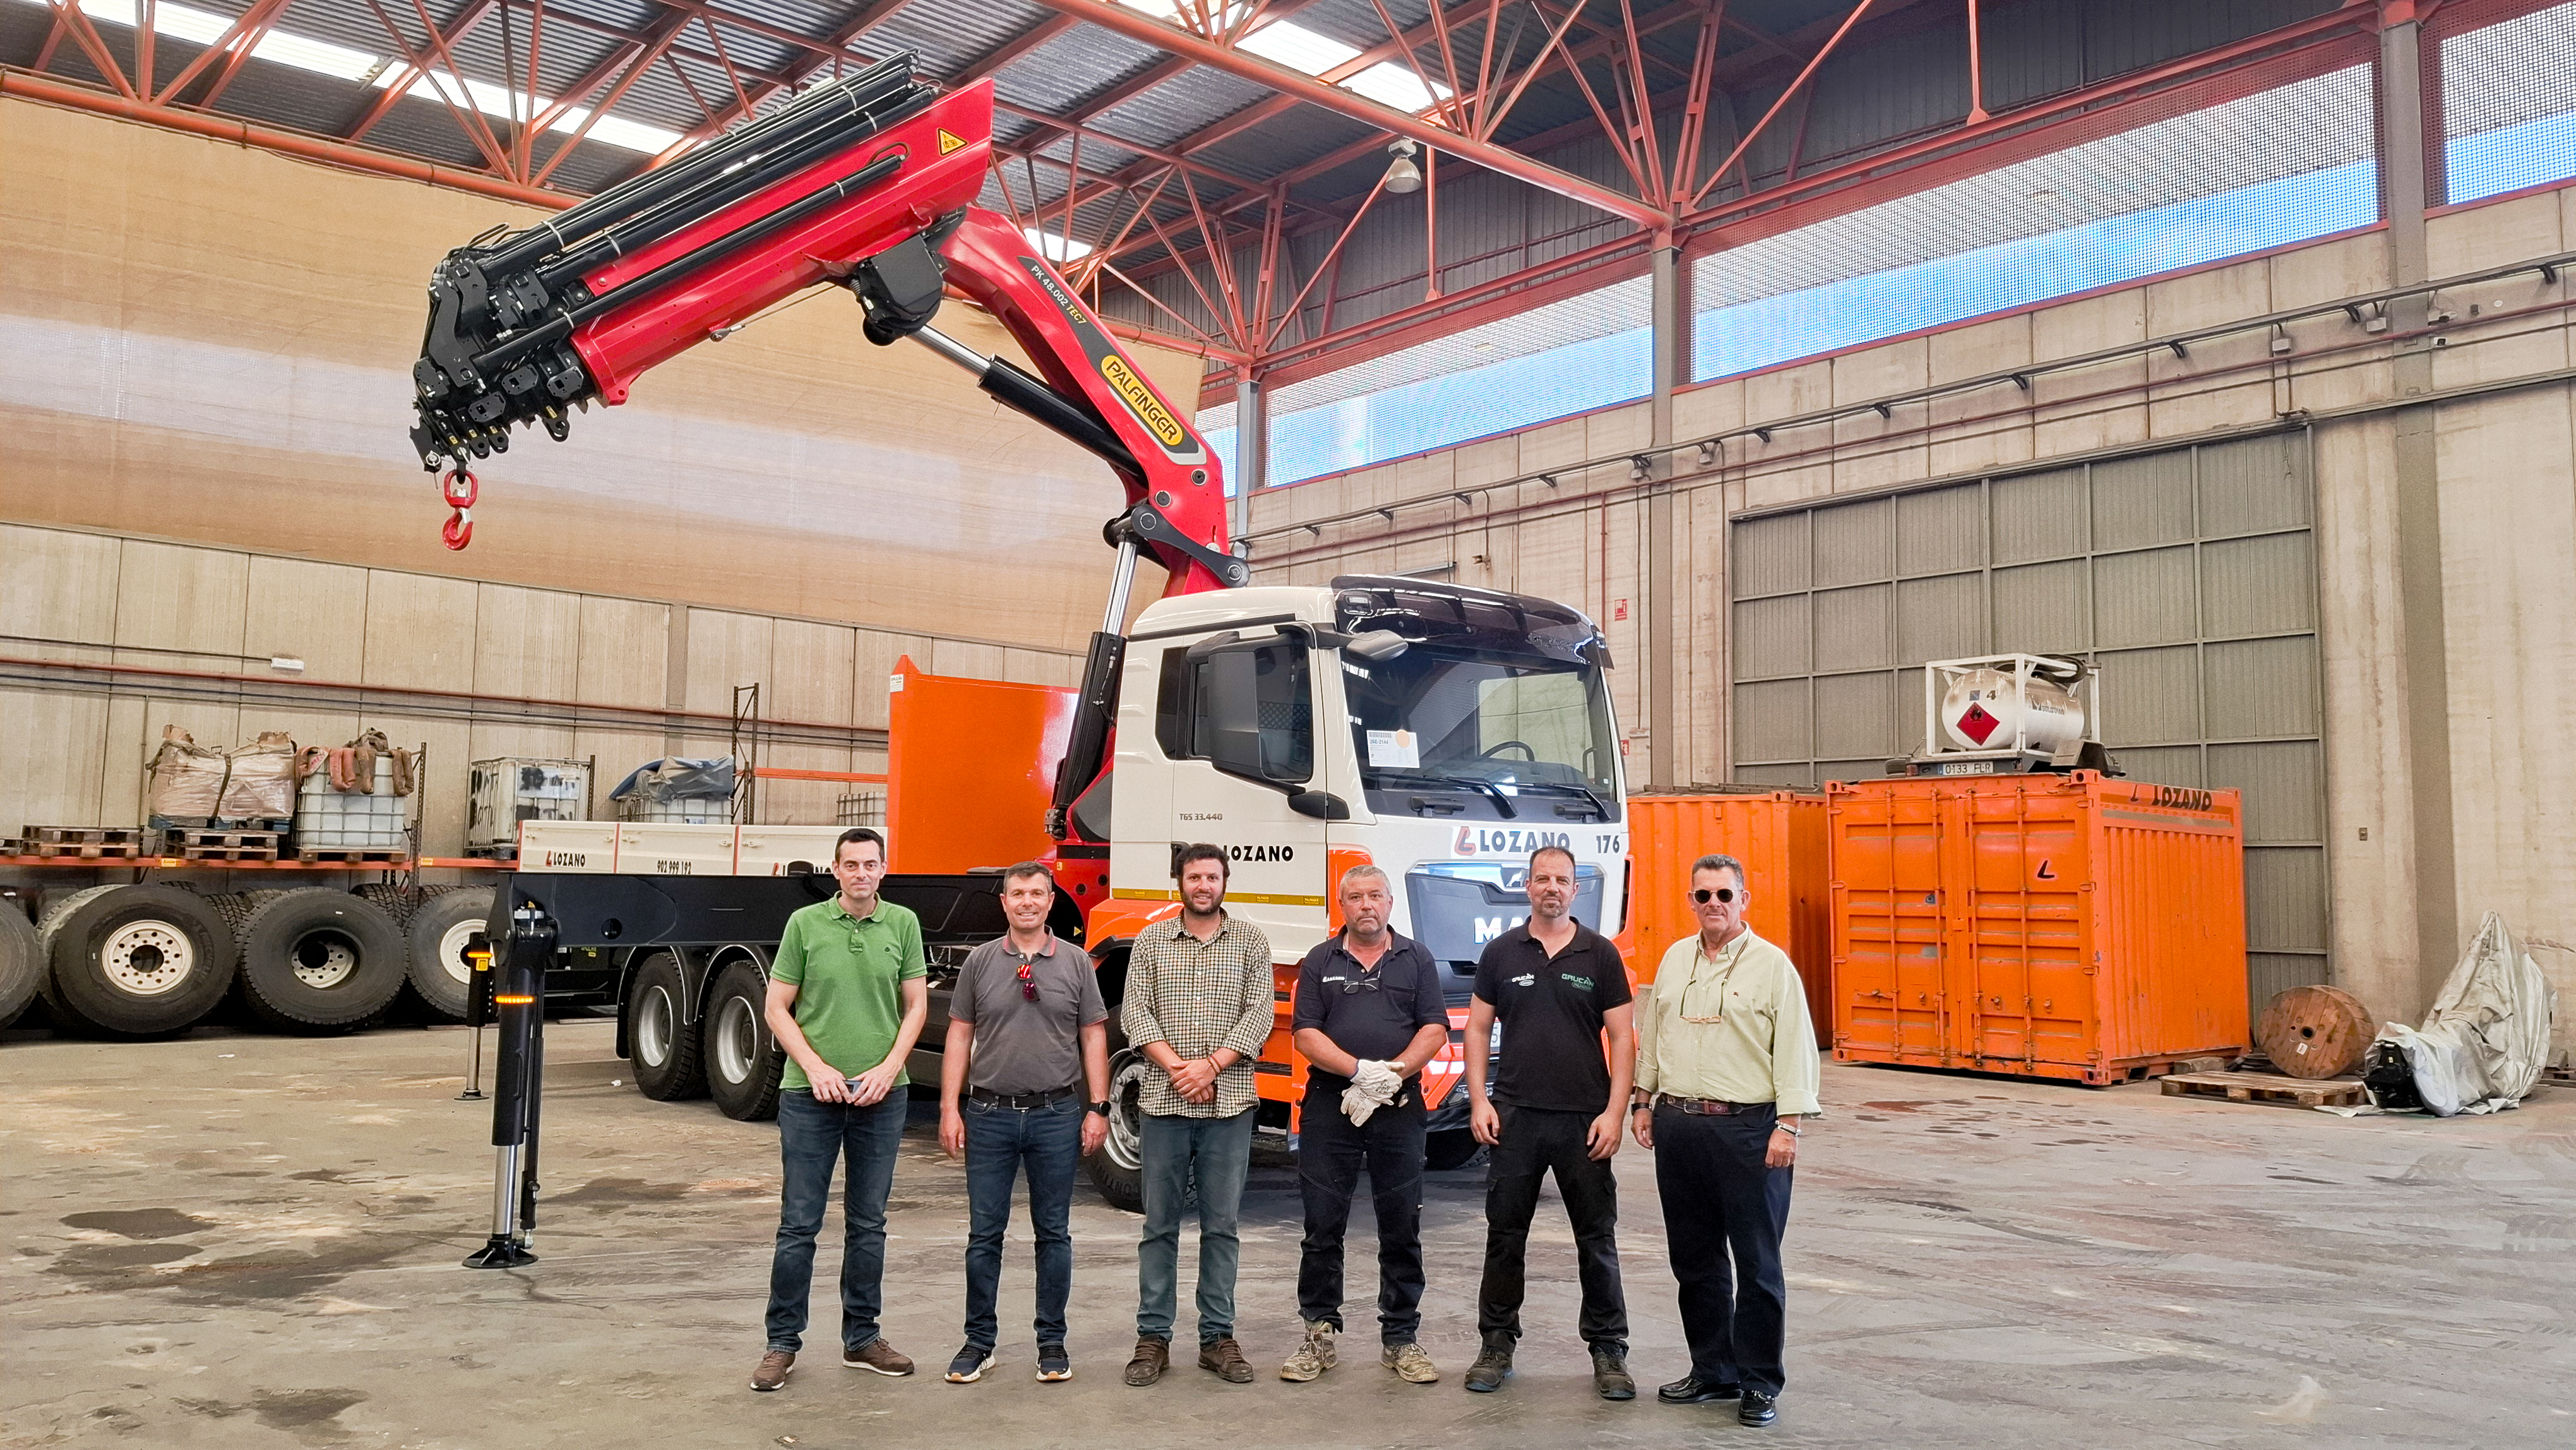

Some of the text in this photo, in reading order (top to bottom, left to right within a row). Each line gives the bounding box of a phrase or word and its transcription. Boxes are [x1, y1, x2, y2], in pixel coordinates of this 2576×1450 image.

[1031, 265, 1087, 324] PK 48.002 TEC7
[1106, 361, 1178, 441] PALFINGER
[1945, 762, 1991, 774] 0133 FLR
[2151, 785, 2212, 812] LOZANO
[1596, 835, 1620, 854] 176
[553, 853, 586, 867] LOZANO
[657, 860, 691, 875] 902 999 192
